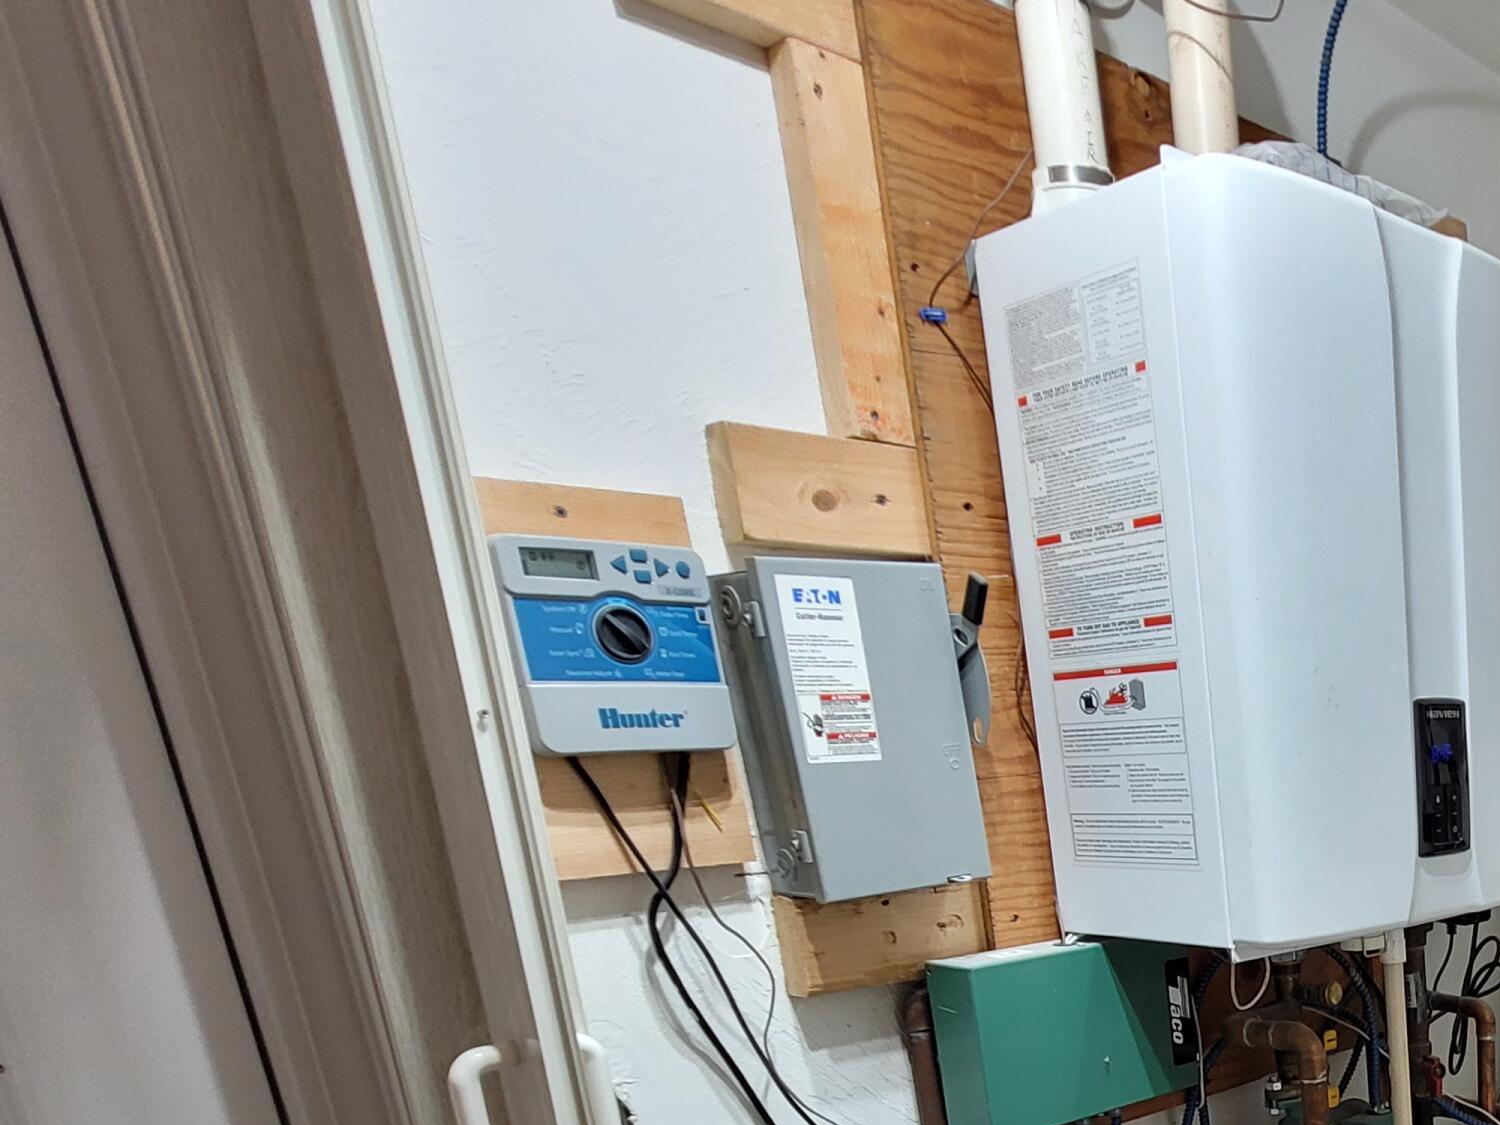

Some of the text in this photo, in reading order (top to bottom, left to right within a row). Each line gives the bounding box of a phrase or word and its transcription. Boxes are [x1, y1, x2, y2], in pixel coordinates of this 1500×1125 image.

[791, 587, 841, 604] EATON
[598, 708, 685, 729] Hunter
[1167, 975, 1190, 1045] Taco
